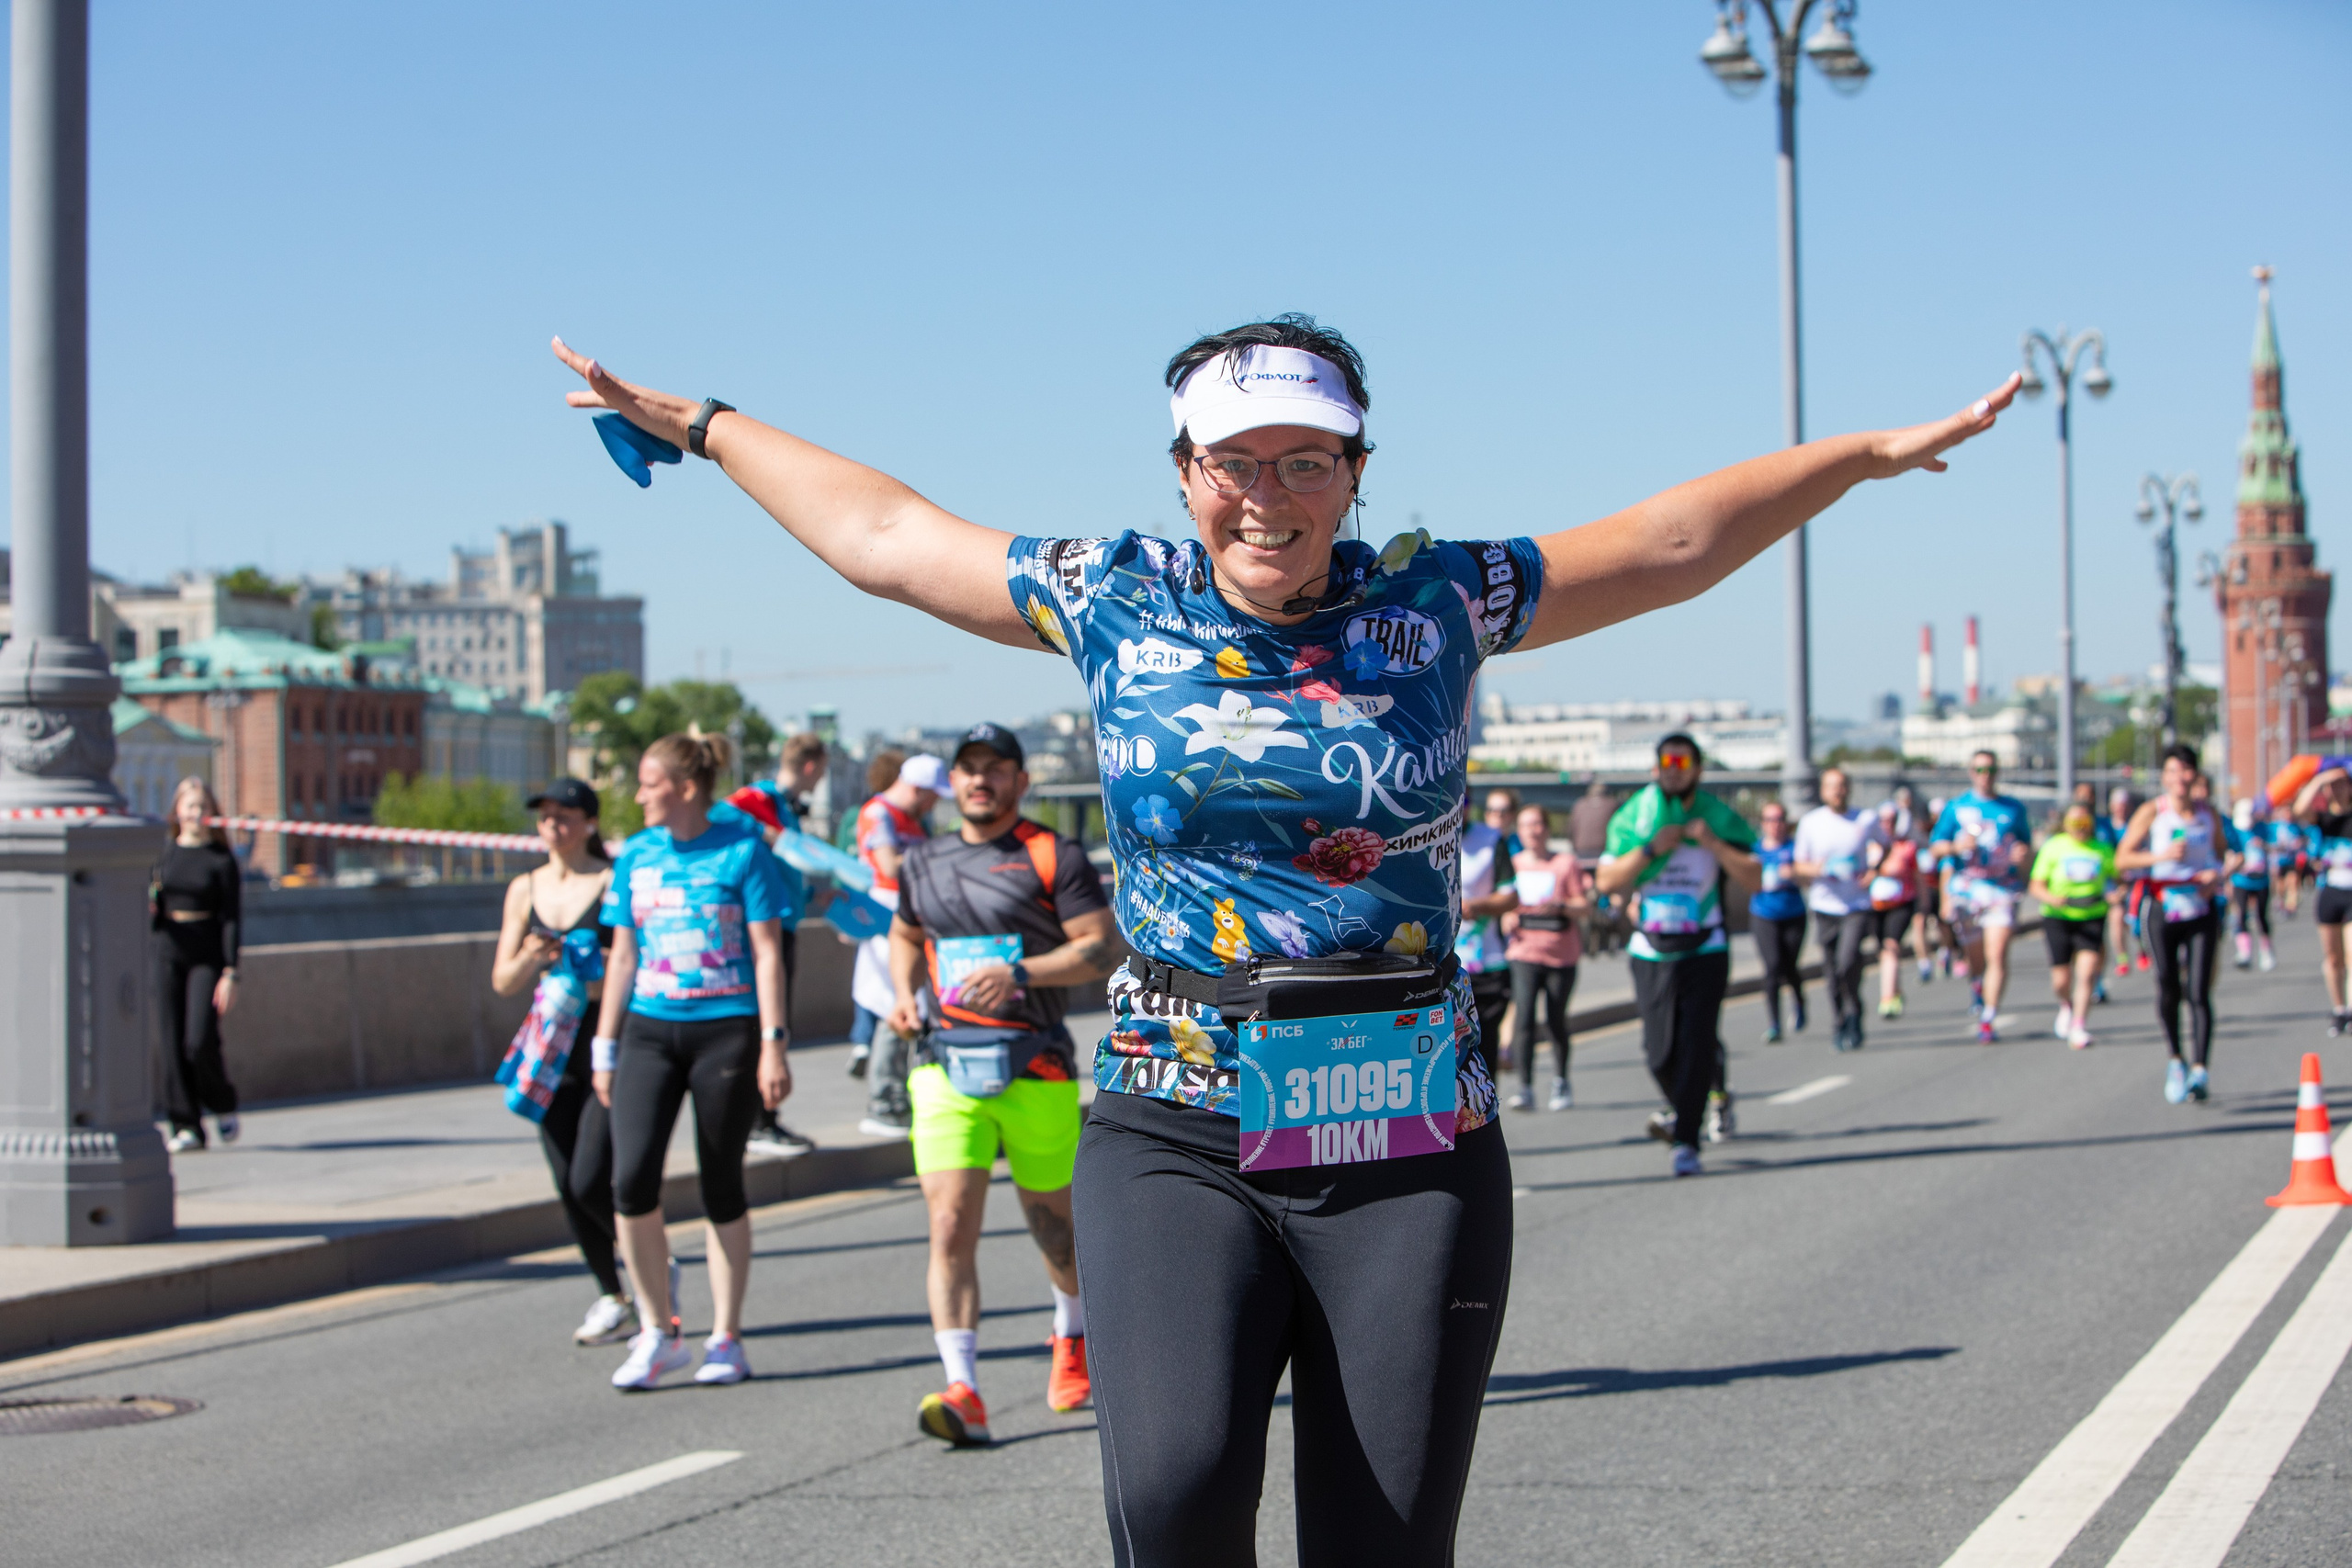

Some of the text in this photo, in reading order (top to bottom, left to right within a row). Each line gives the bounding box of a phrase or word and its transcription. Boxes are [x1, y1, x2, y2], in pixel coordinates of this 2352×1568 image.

[1361, 617, 1426, 667] TRAIL
[1136, 649, 1182, 668] KRB
[1337, 699, 1379, 718] KRB
[1430, 1010, 1443, 1018] FON
[1430, 1016, 1443, 1024] BET
[1272, 1025, 1304, 1039] ПСБ
[1418, 1035, 1433, 1055] D
[1284, 1058, 1413, 1120] 31095
[1307, 1118, 1388, 1166] 10KM
